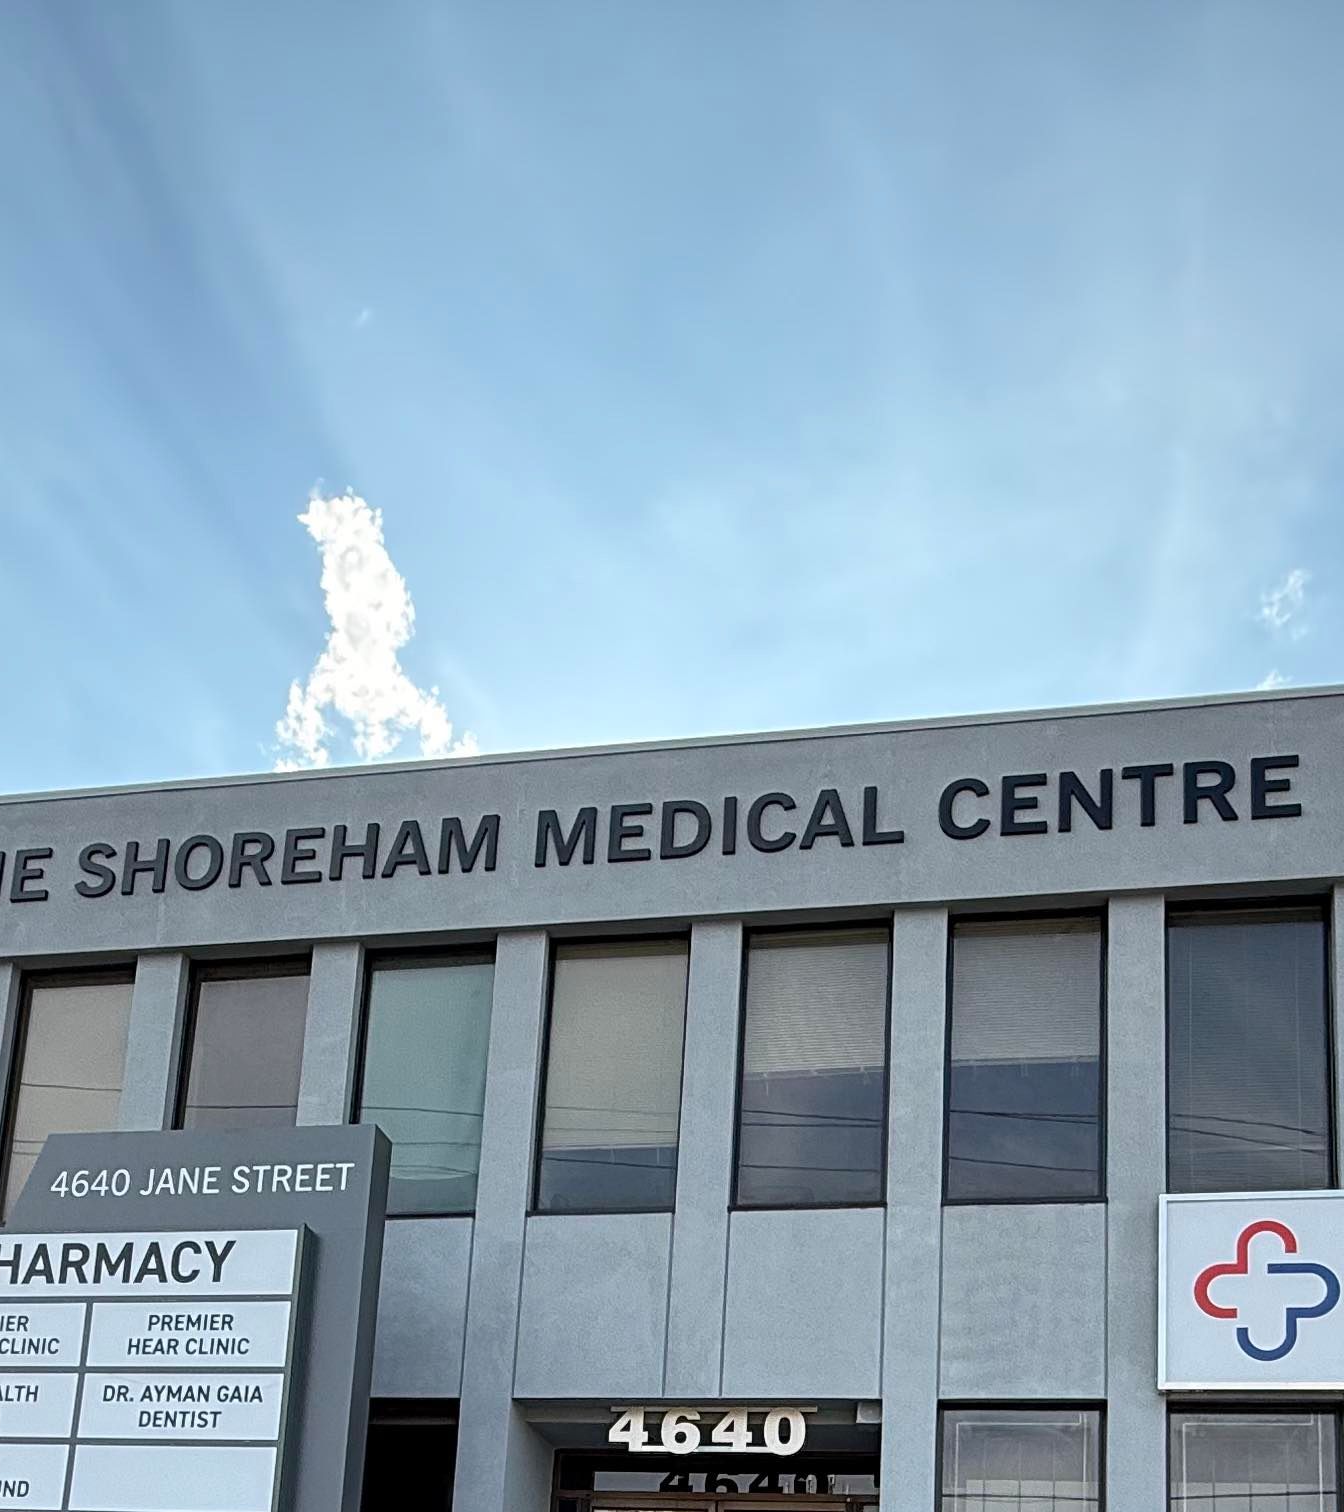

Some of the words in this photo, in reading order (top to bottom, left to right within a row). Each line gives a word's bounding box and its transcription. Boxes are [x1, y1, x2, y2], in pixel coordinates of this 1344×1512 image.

[74, 814, 501, 899] SHOREHAM
[534, 785, 905, 869] MEDICAL
[938, 754, 1303, 841] CENTRE
[50, 1168, 131, 1198] 4640
[139, 1166, 222, 1196] JANE
[231, 1162, 356, 1194] STREET
[147, 1313, 234, 1332] PREMIER
[127, 1338, 180, 1355] HEAR
[185, 1337, 250, 1355] CLINIC
[102, 1384, 135, 1402] DR.
[139, 1385, 211, 1403] AYMAN
[216, 1385, 263, 1403] GAIA
[138, 1410, 222, 1429] DENTIST
[608, 1407, 806, 1456] 4640
